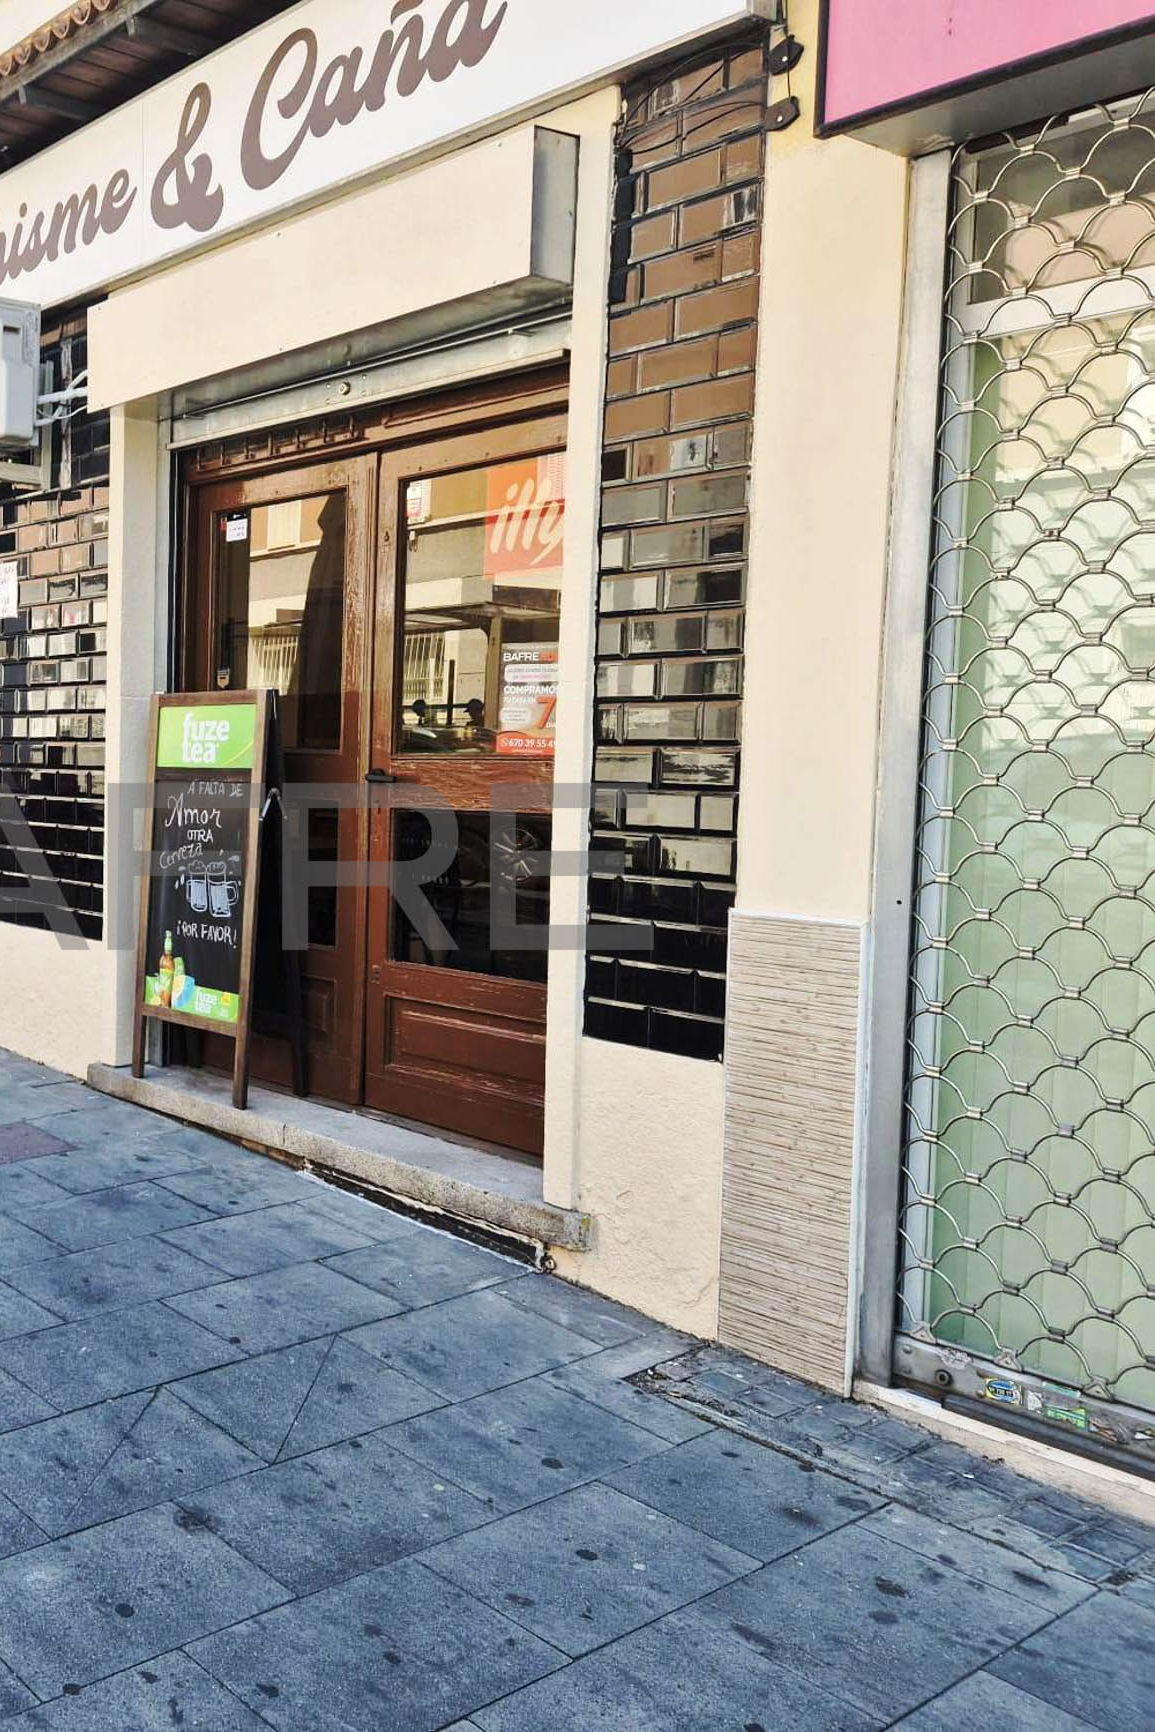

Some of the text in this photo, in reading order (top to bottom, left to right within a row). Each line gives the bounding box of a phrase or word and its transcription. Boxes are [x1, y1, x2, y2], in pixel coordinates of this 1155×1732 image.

[150, 82, 224, 232] &
[241, 0, 508, 191] Caña
[491, 477, 565, 566] illy
[503, 651, 540, 662] BAFRE
[183, 711, 230, 742] fuze
[183, 742, 217, 763] tea
[199, 781, 225, 795] FALTA
[229, 783, 244, 797] DE
[165, 793, 222, 828] Amor
[187, 829, 214, 843] OTRA
[159, 842, 203, 869] Cerveza
[201, 924, 237, 949] FAVOR!
